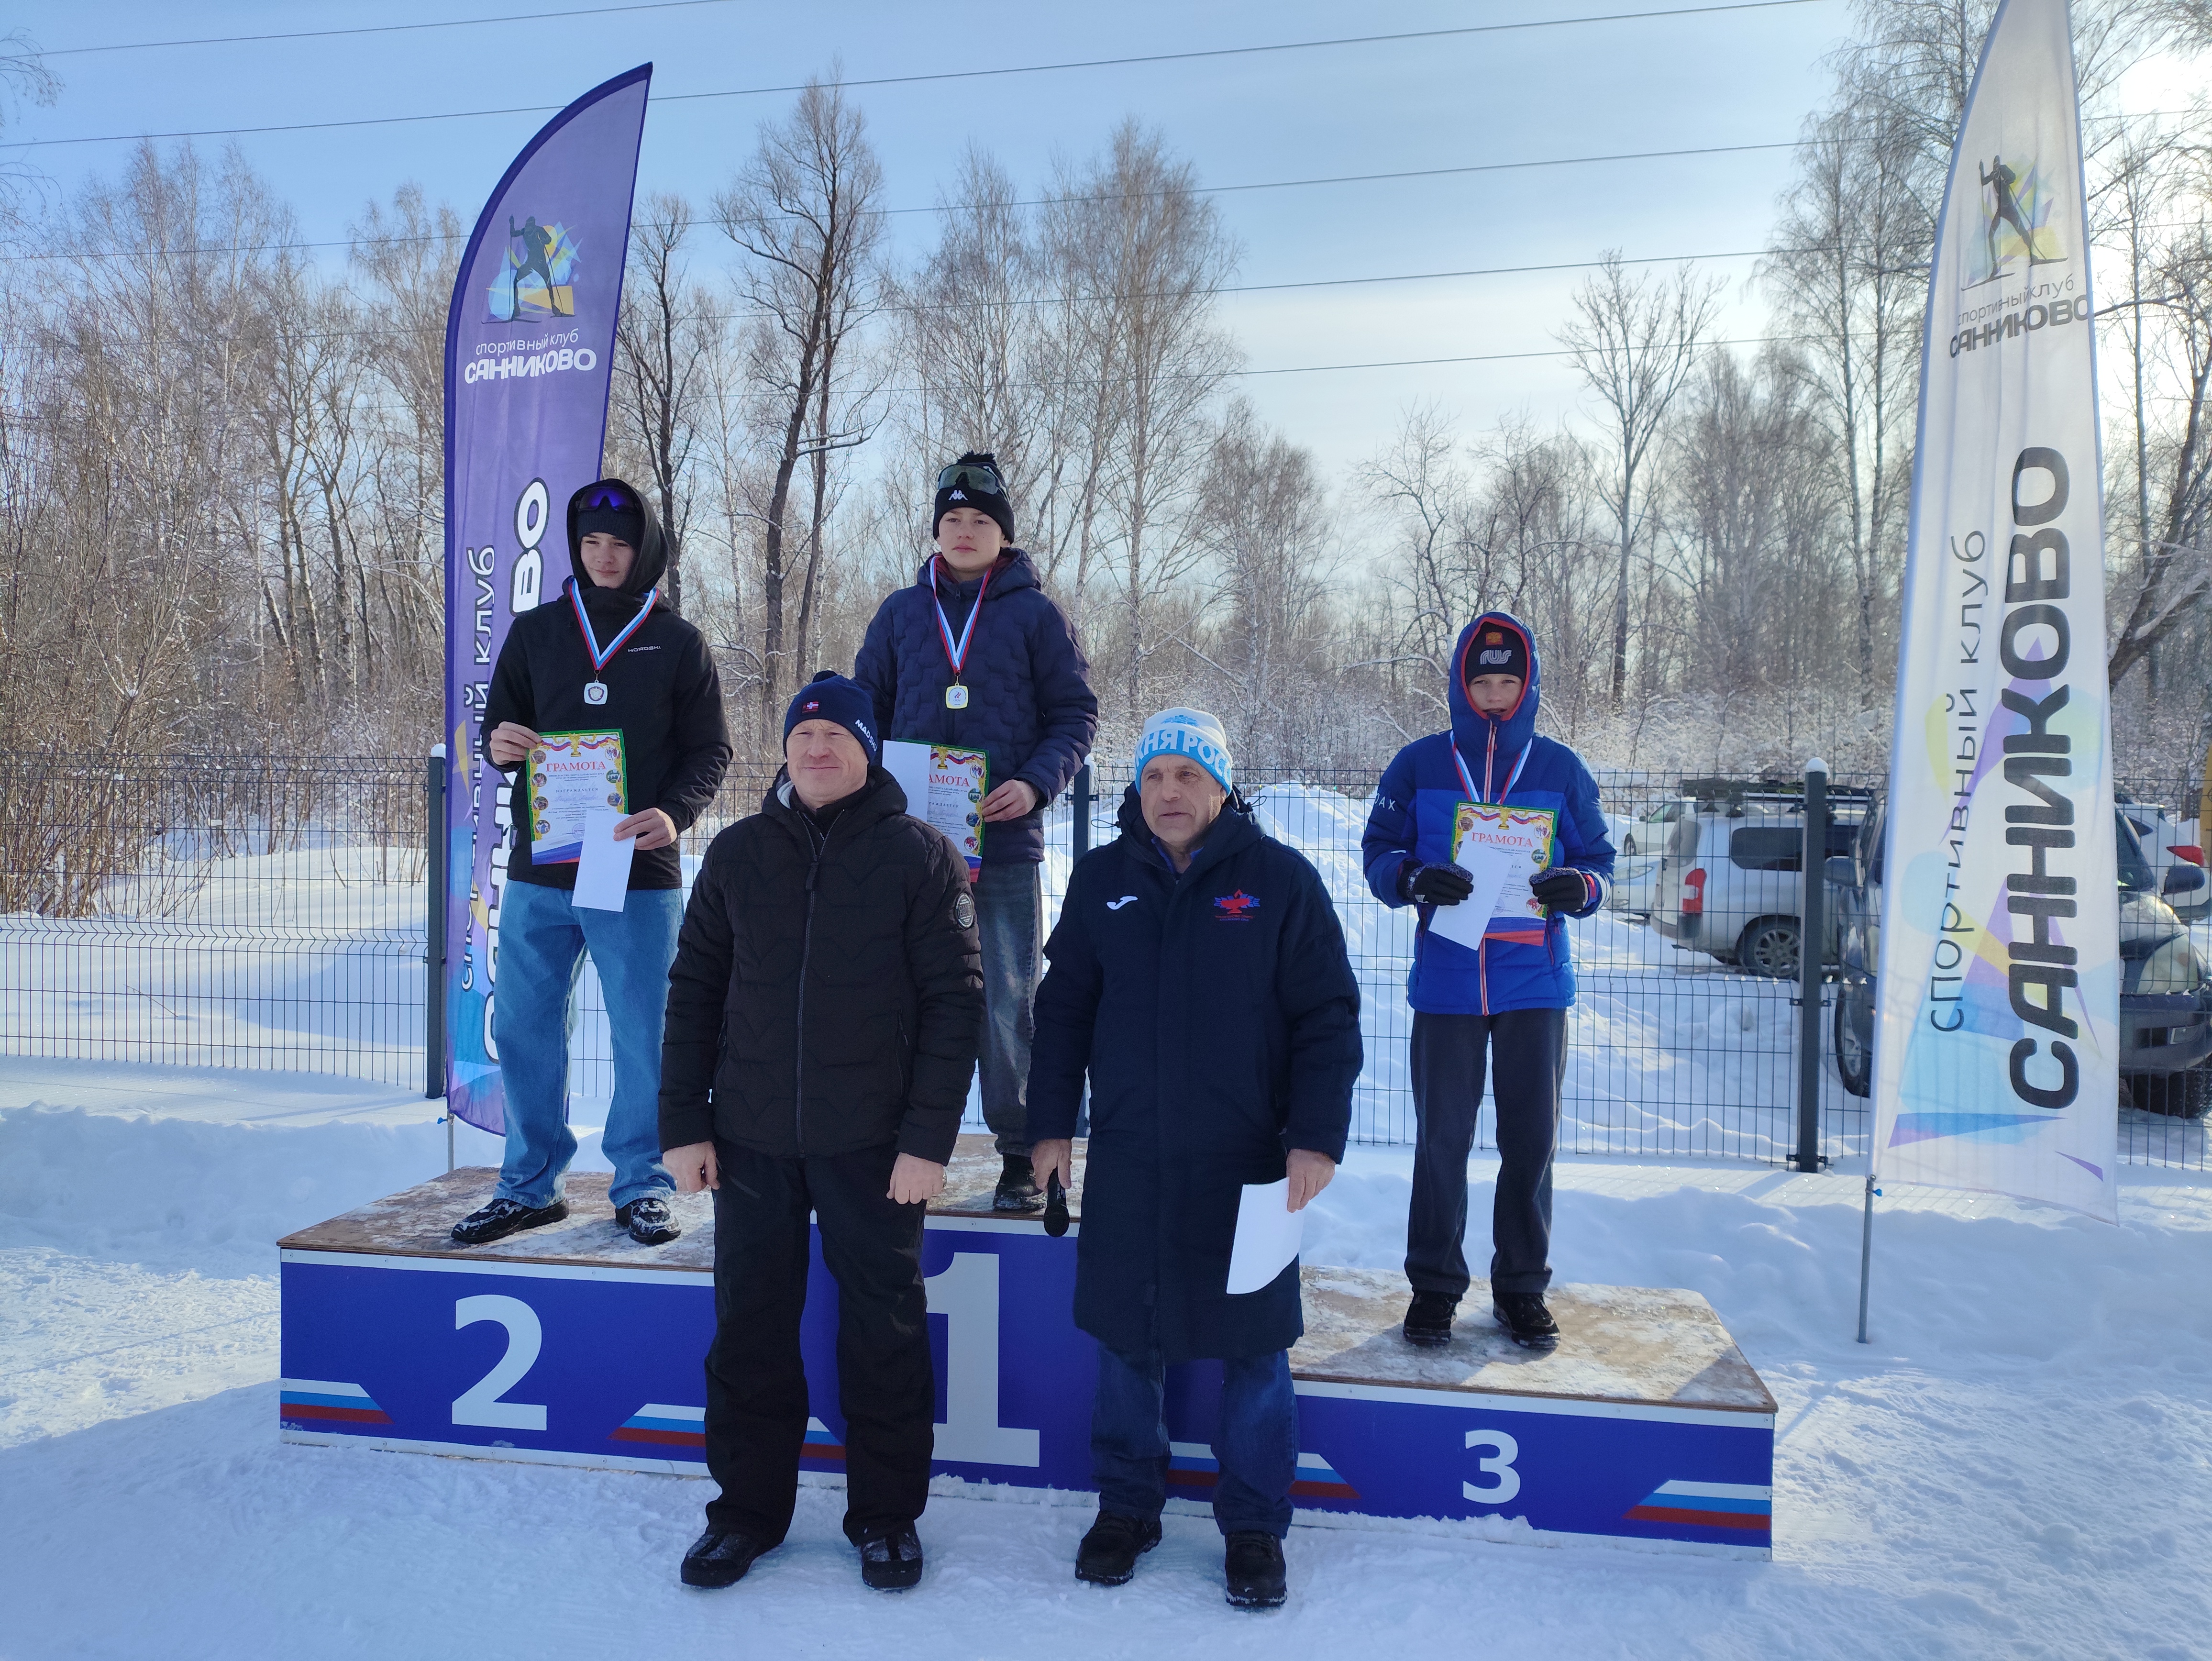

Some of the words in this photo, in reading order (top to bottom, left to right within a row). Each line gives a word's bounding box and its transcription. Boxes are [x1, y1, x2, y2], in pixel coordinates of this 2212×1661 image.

[2030, 273, 2074, 299] клуб
[476, 332, 548, 357] спортивный
[550, 328, 579, 347] клуб
[1950, 294, 2089, 358] САННИКОВО
[464, 348, 597, 384] САННИКОВО
[1951, 531, 1988, 663] клуб
[855, 719, 877, 752] MADSHU
[1134, 730, 1178, 768] ЖНЯ
[546, 761, 607, 773] ГРАМОТА
[929, 773, 970, 787] АМОТА
[2000, 446, 2079, 1109] САННИКОВО
[1471, 832, 1534, 848] ГРАМОТА
[452, 1294, 547, 1431] 2
[922, 1251, 1040, 1468] 1
[1462, 1429, 1520, 1505] 3
